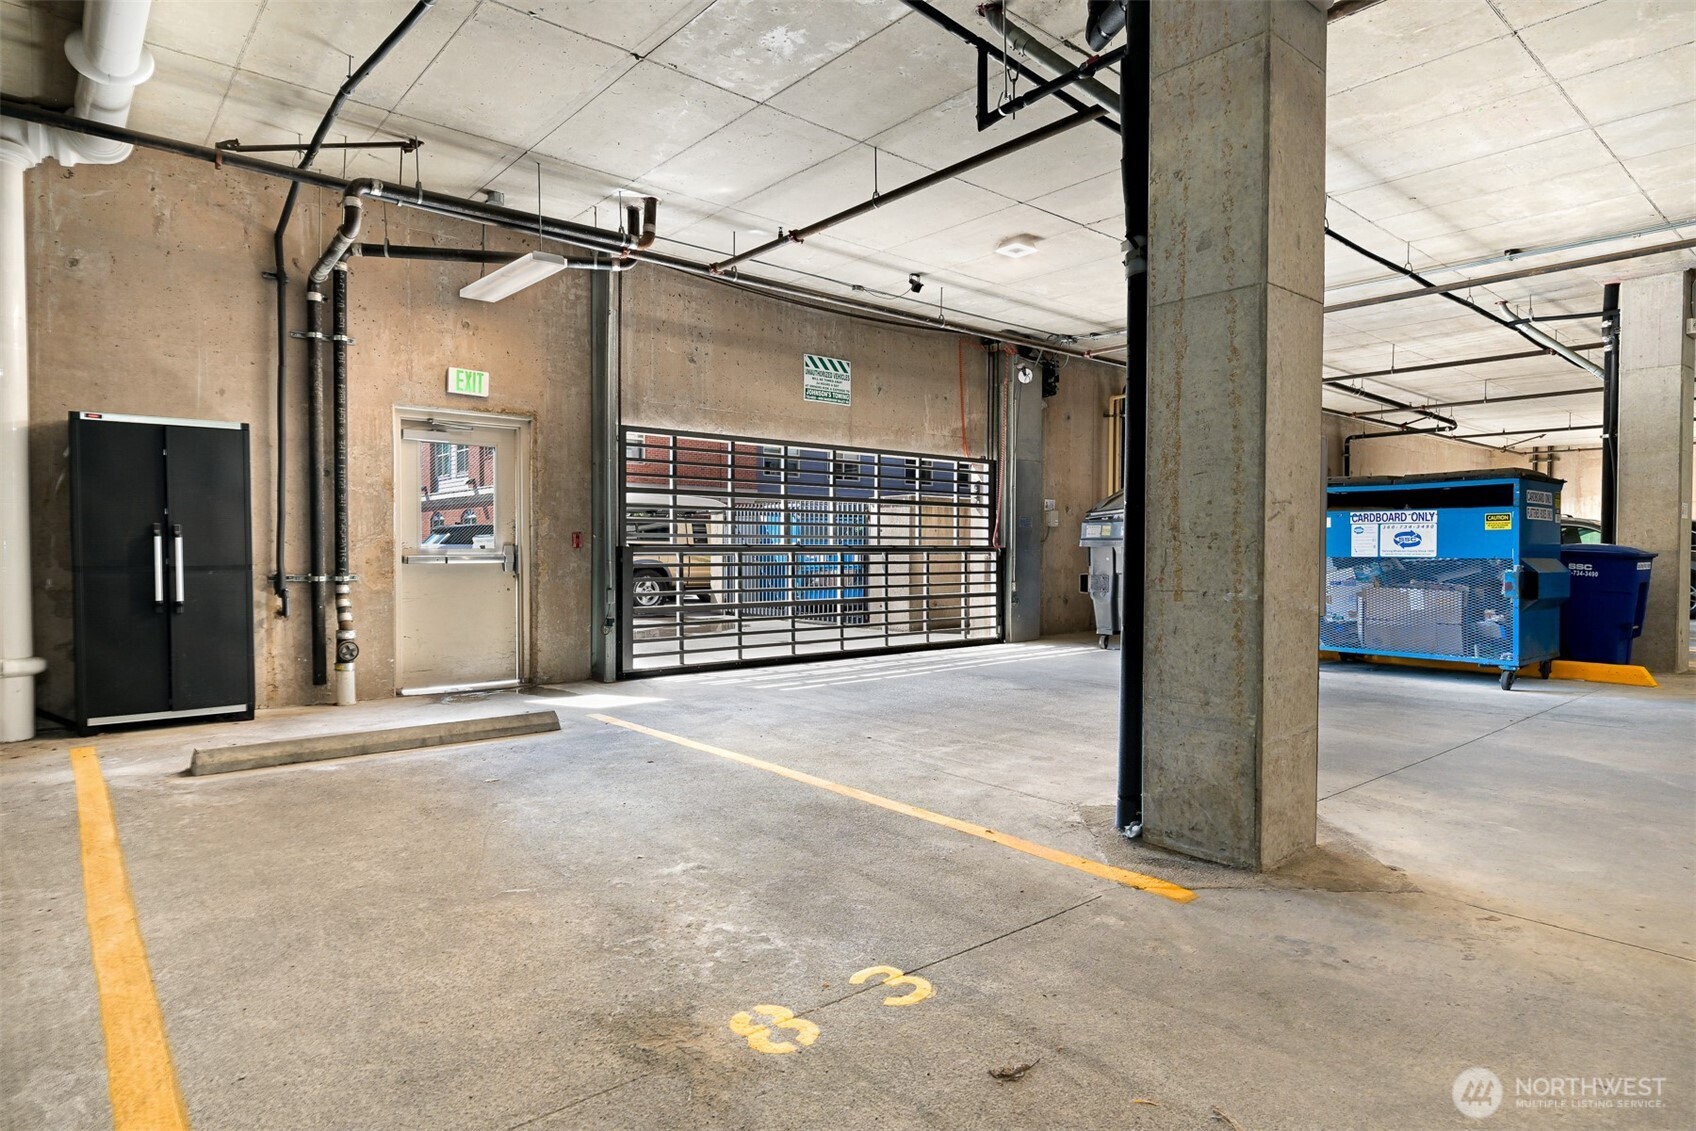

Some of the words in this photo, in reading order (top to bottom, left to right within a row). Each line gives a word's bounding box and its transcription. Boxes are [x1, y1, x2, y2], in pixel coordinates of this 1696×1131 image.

[456, 369, 484, 393] EXIT
[805, 369, 832, 378] UNAUTHORIZED
[833, 373, 850, 382] VEHICLES
[806, 389, 832, 398] JOHNSON'S
[832, 392, 850, 400] TOWING
[1351, 512, 1407, 523] CARDBOARD
[1411, 511, 1436, 521] ONLY
